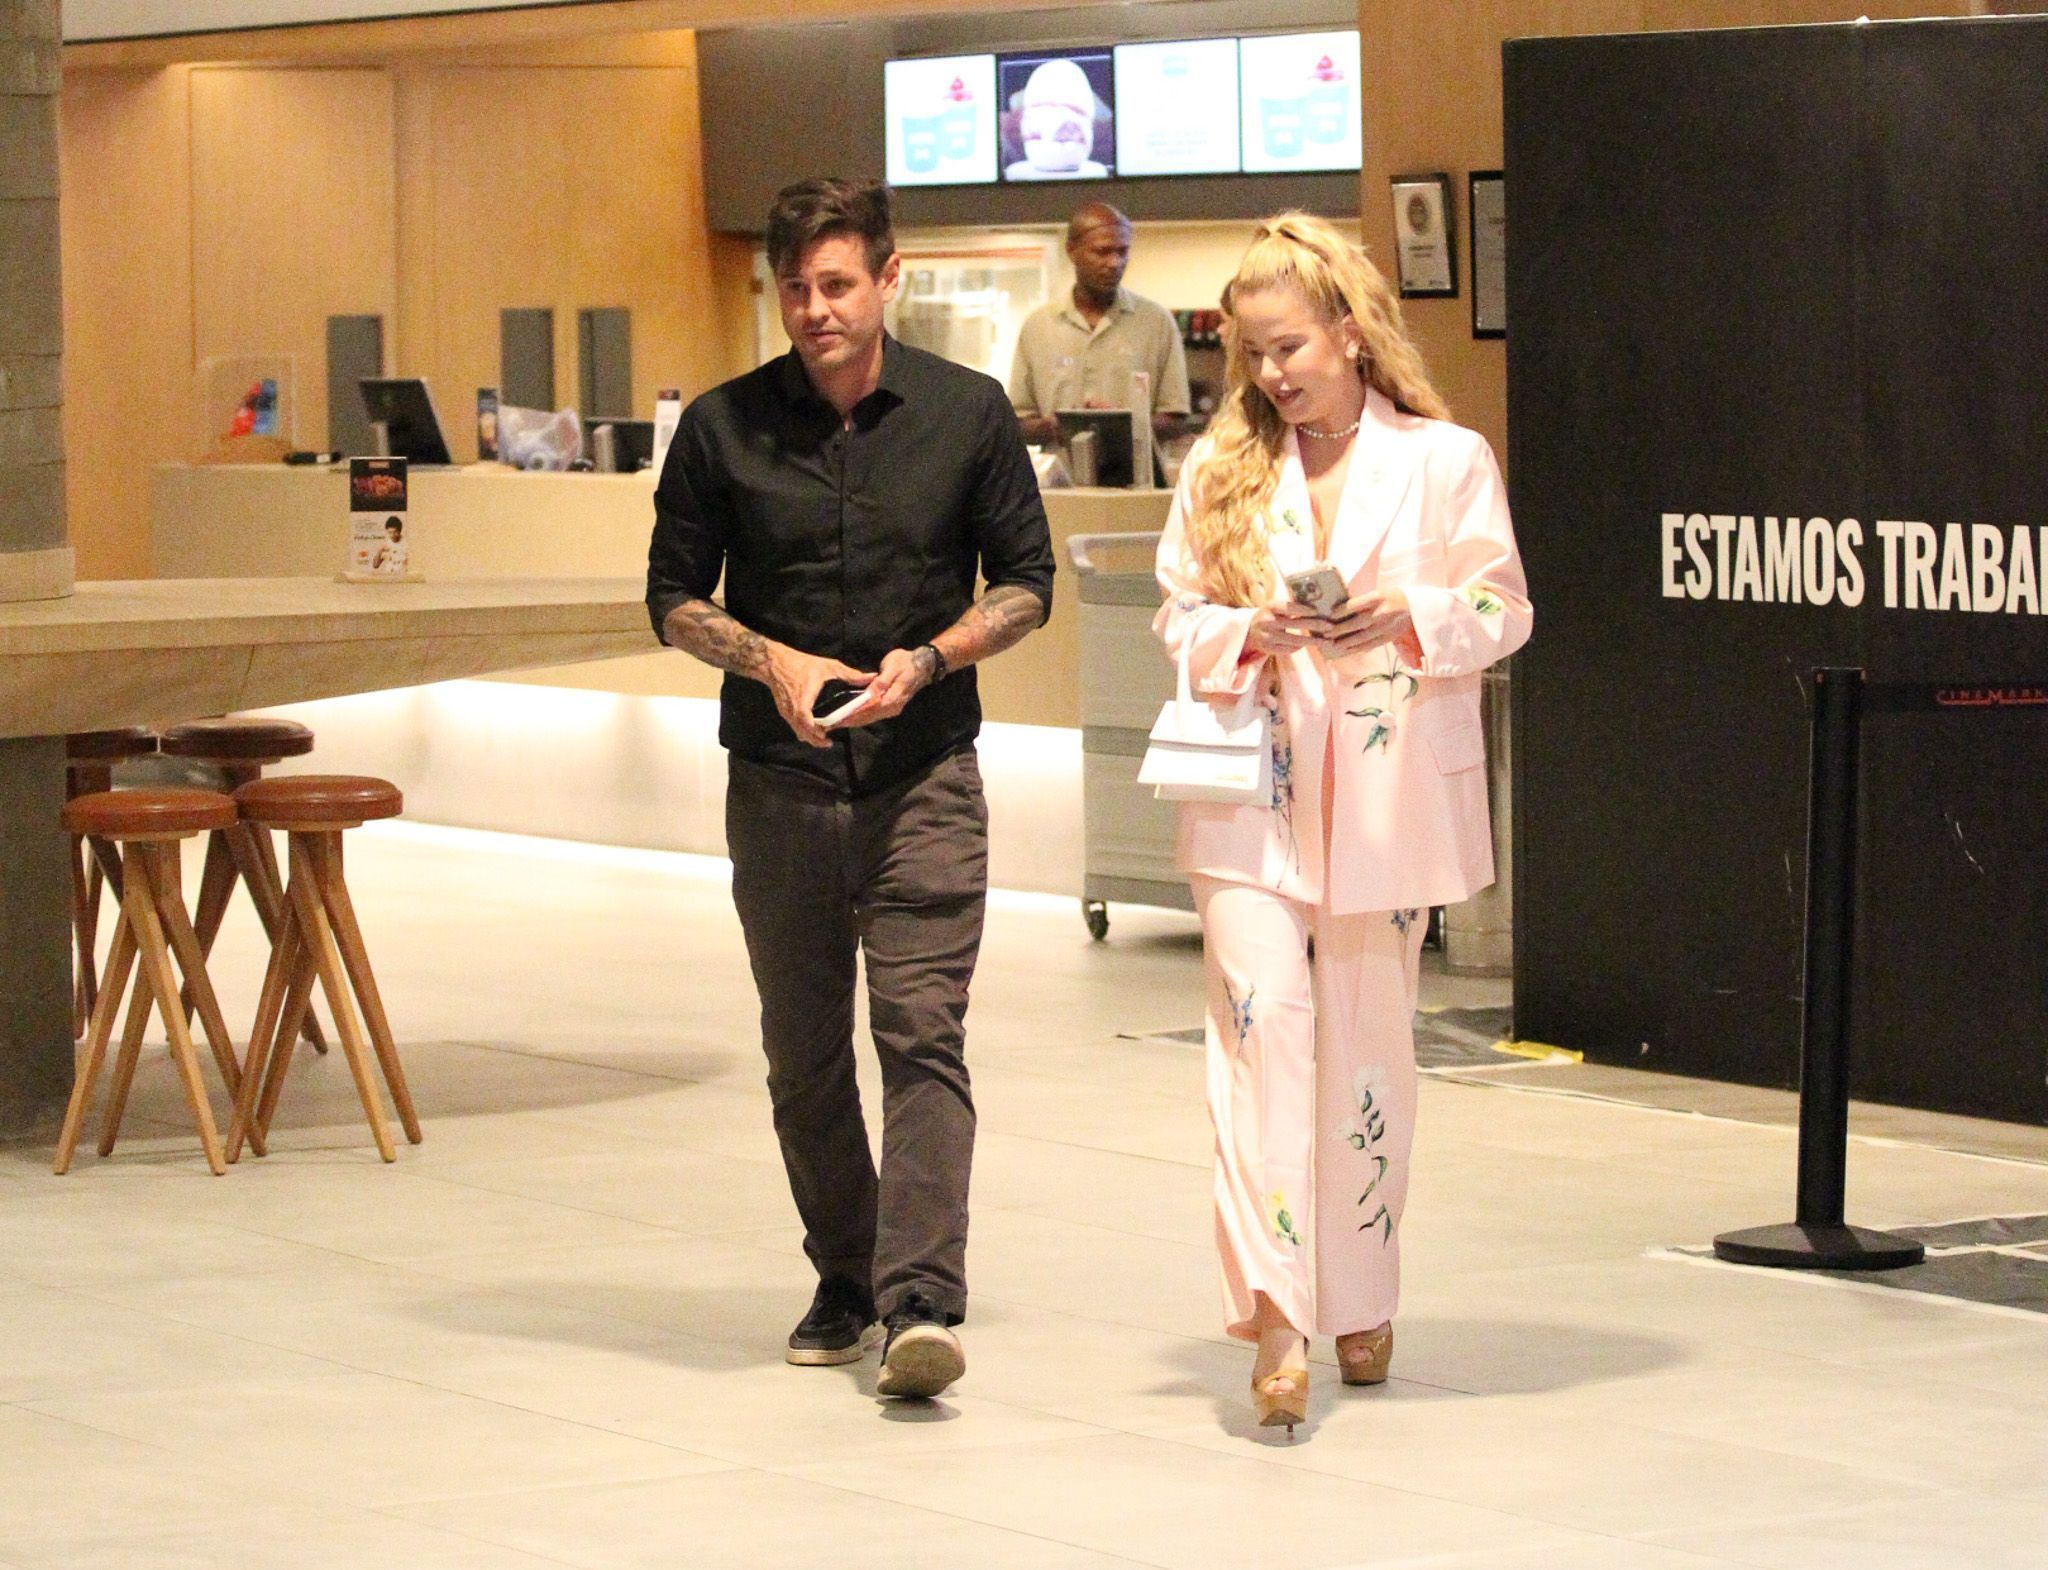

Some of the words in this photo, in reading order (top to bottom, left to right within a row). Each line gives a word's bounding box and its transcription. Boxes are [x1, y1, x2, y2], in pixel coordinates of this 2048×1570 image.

[1662, 513, 1865, 607] ESTAMOS
[1876, 519, 2048, 615] TRABA
[1936, 688, 2045, 704] CINEMARK
